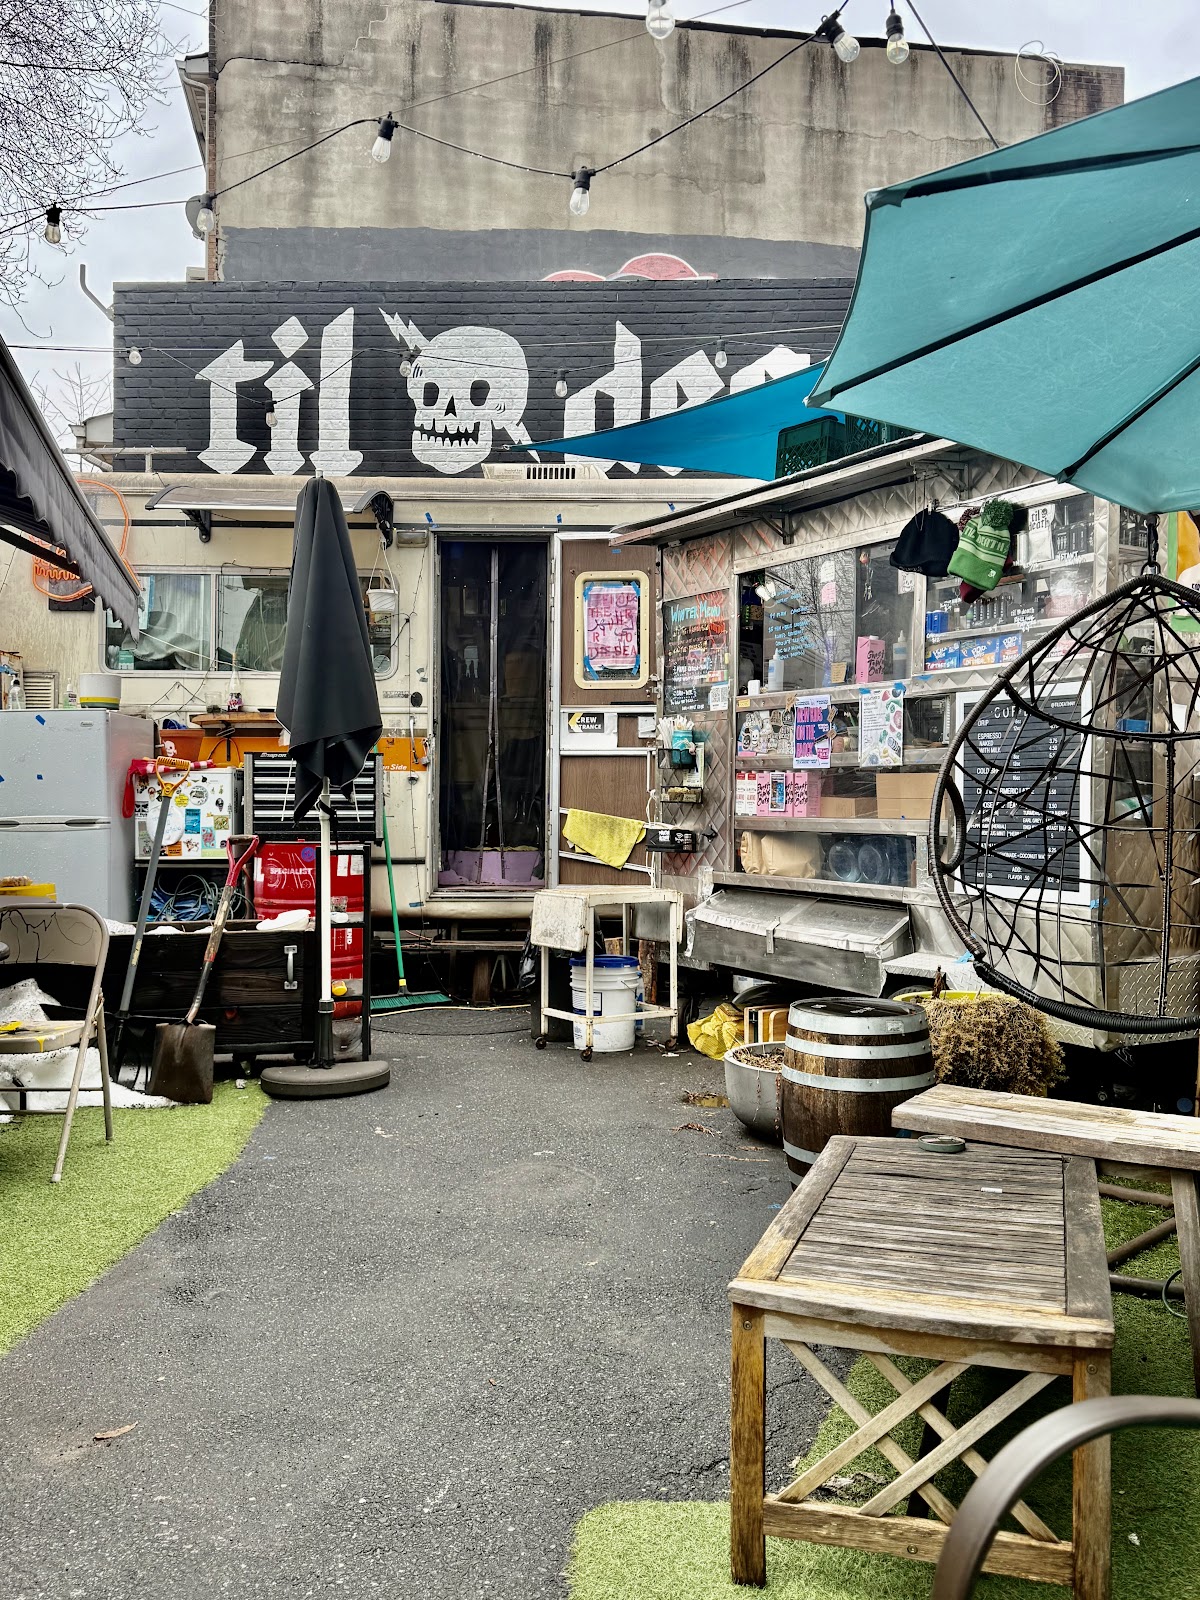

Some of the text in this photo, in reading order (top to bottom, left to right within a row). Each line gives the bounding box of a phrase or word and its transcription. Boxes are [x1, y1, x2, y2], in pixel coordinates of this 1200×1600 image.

[193, 306, 363, 475] til
[977, 732, 1002, 740] ESPRESSO
[390, 763, 408, 771] Side
[269, 867, 313, 875] SPECIALIST
